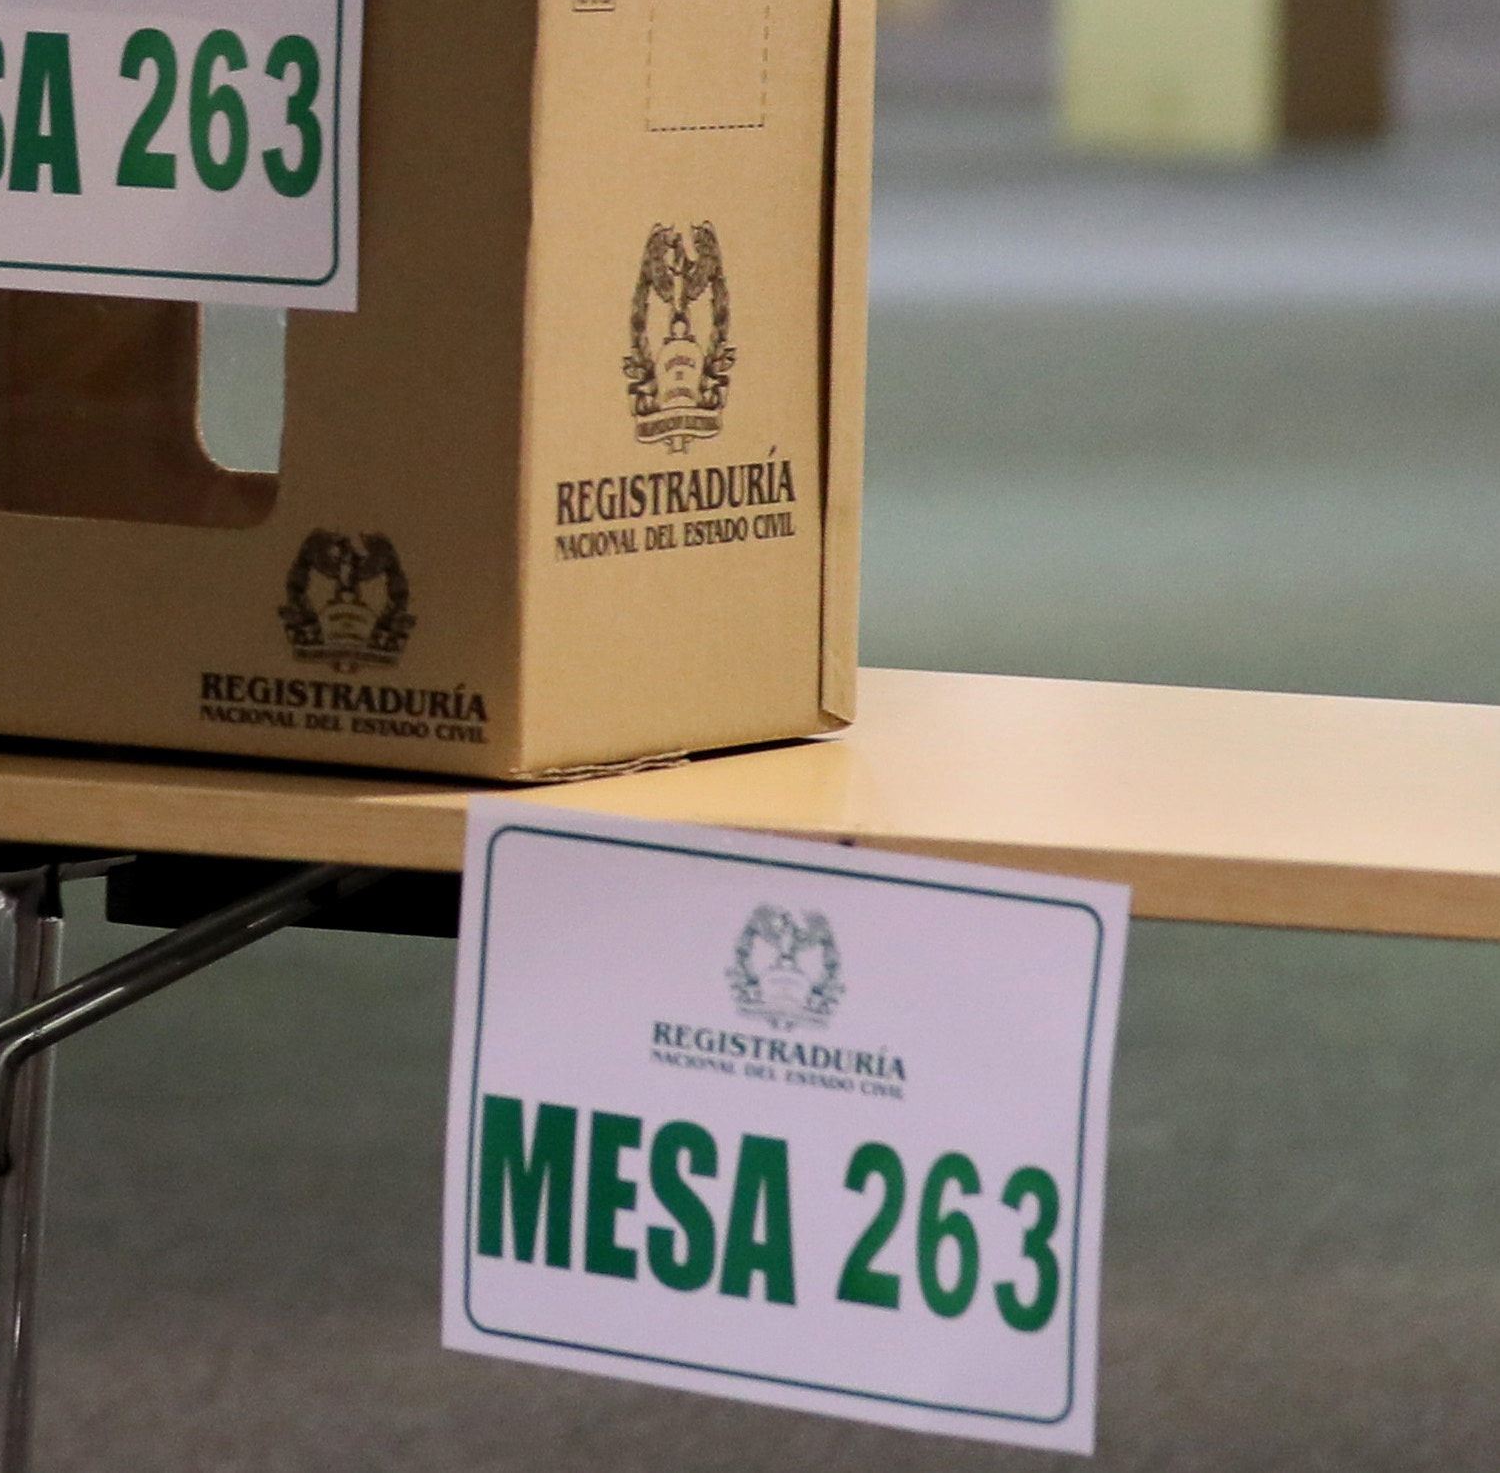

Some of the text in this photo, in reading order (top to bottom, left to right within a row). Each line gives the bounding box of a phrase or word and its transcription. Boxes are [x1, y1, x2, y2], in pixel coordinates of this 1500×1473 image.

[115, 27, 322, 198] 263
[556, 444, 796, 526] REGISTRADURÍA
[555, 512, 795, 562] NACIONAL DEL ESTADO CIVIL
[201, 671, 488, 722] REGISTRADURÍA
[201, 706, 488, 744] NACIONAL DEL ESTADO CIVIL
[653, 1020, 907, 1080] REGISTRADURÍA
[744, 1062, 776, 1081] DEL
[785, 1068, 854, 1092] ESTADO
[860, 1079, 904, 1100] CIVIL
[476, 1093, 1061, 1333] MESA 263
